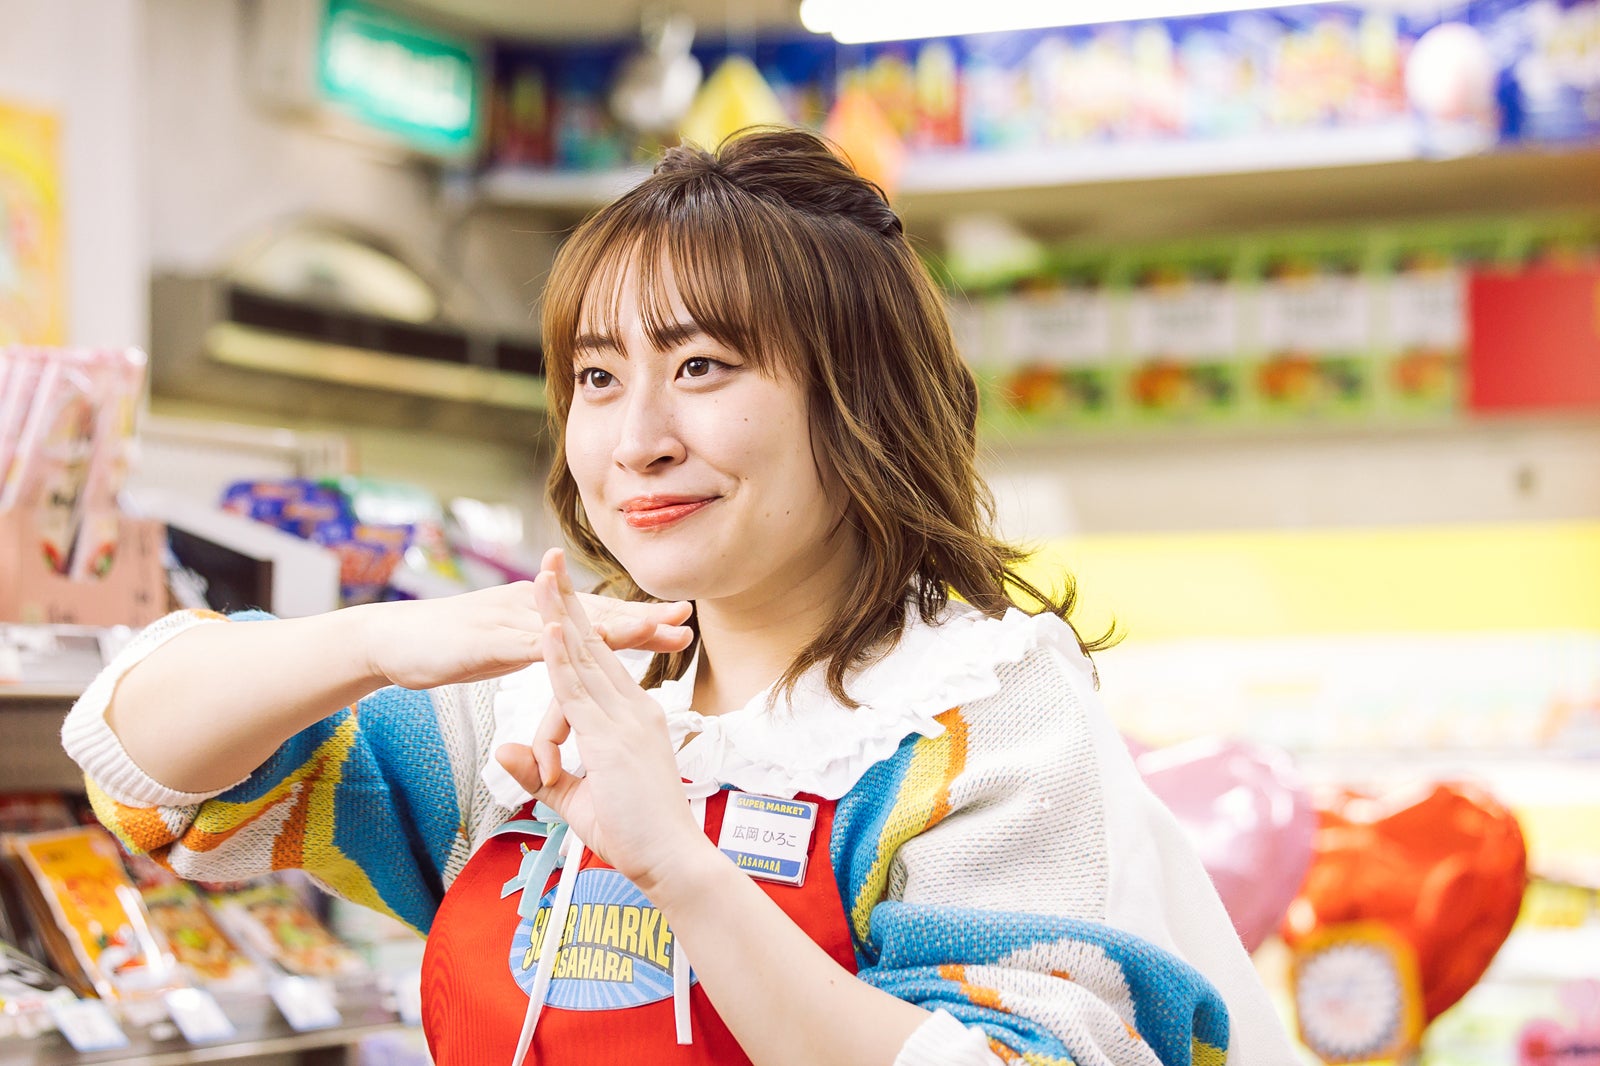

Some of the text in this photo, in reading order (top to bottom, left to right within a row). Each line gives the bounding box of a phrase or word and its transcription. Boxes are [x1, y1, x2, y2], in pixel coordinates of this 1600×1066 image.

[736, 797, 804, 816] SUPER MARKET
[762, 830, 797, 847] ひろこ
[736, 853, 781, 874] SASAHARA
[577, 903, 674, 970] MARKE
[551, 946, 633, 983] ASAHARA
